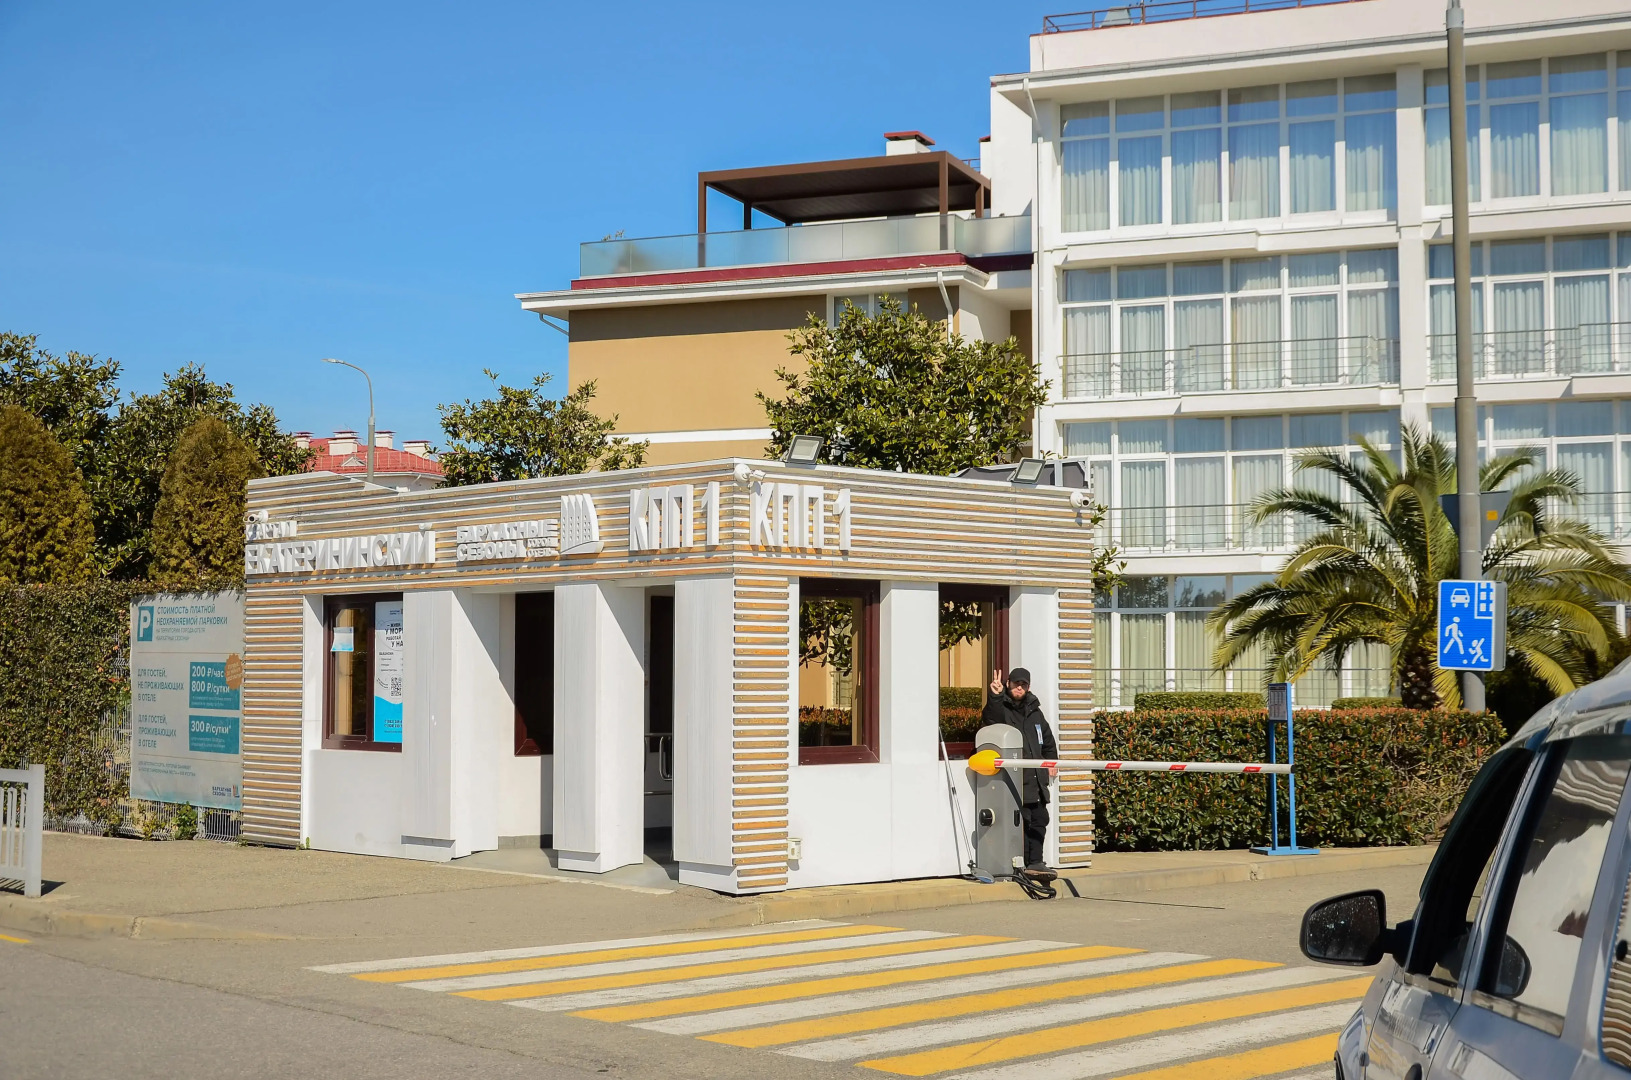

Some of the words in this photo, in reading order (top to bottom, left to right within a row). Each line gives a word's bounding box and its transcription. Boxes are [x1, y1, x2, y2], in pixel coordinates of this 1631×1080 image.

[629, 484, 694, 550] КПП
[701, 481, 720, 546] 1
[750, 482, 824, 548] КПП
[833, 488, 851, 550] 1
[456, 519, 559, 543] БАРХАТНЫЕ
[245, 524, 436, 574] ЕКАТЕРИНИНСКИЙ
[456, 540, 527, 562] СЕЗОНЫ
[157, 606, 189, 615] СТОИМОСТЬ
[190, 604, 216, 614] ПЛАТНОЙ
[199, 616, 228, 626] ПАРКОВКИ
[191, 665, 206, 678] 200
[191, 680, 206, 693] 800
[190, 720, 205, 733] 300
